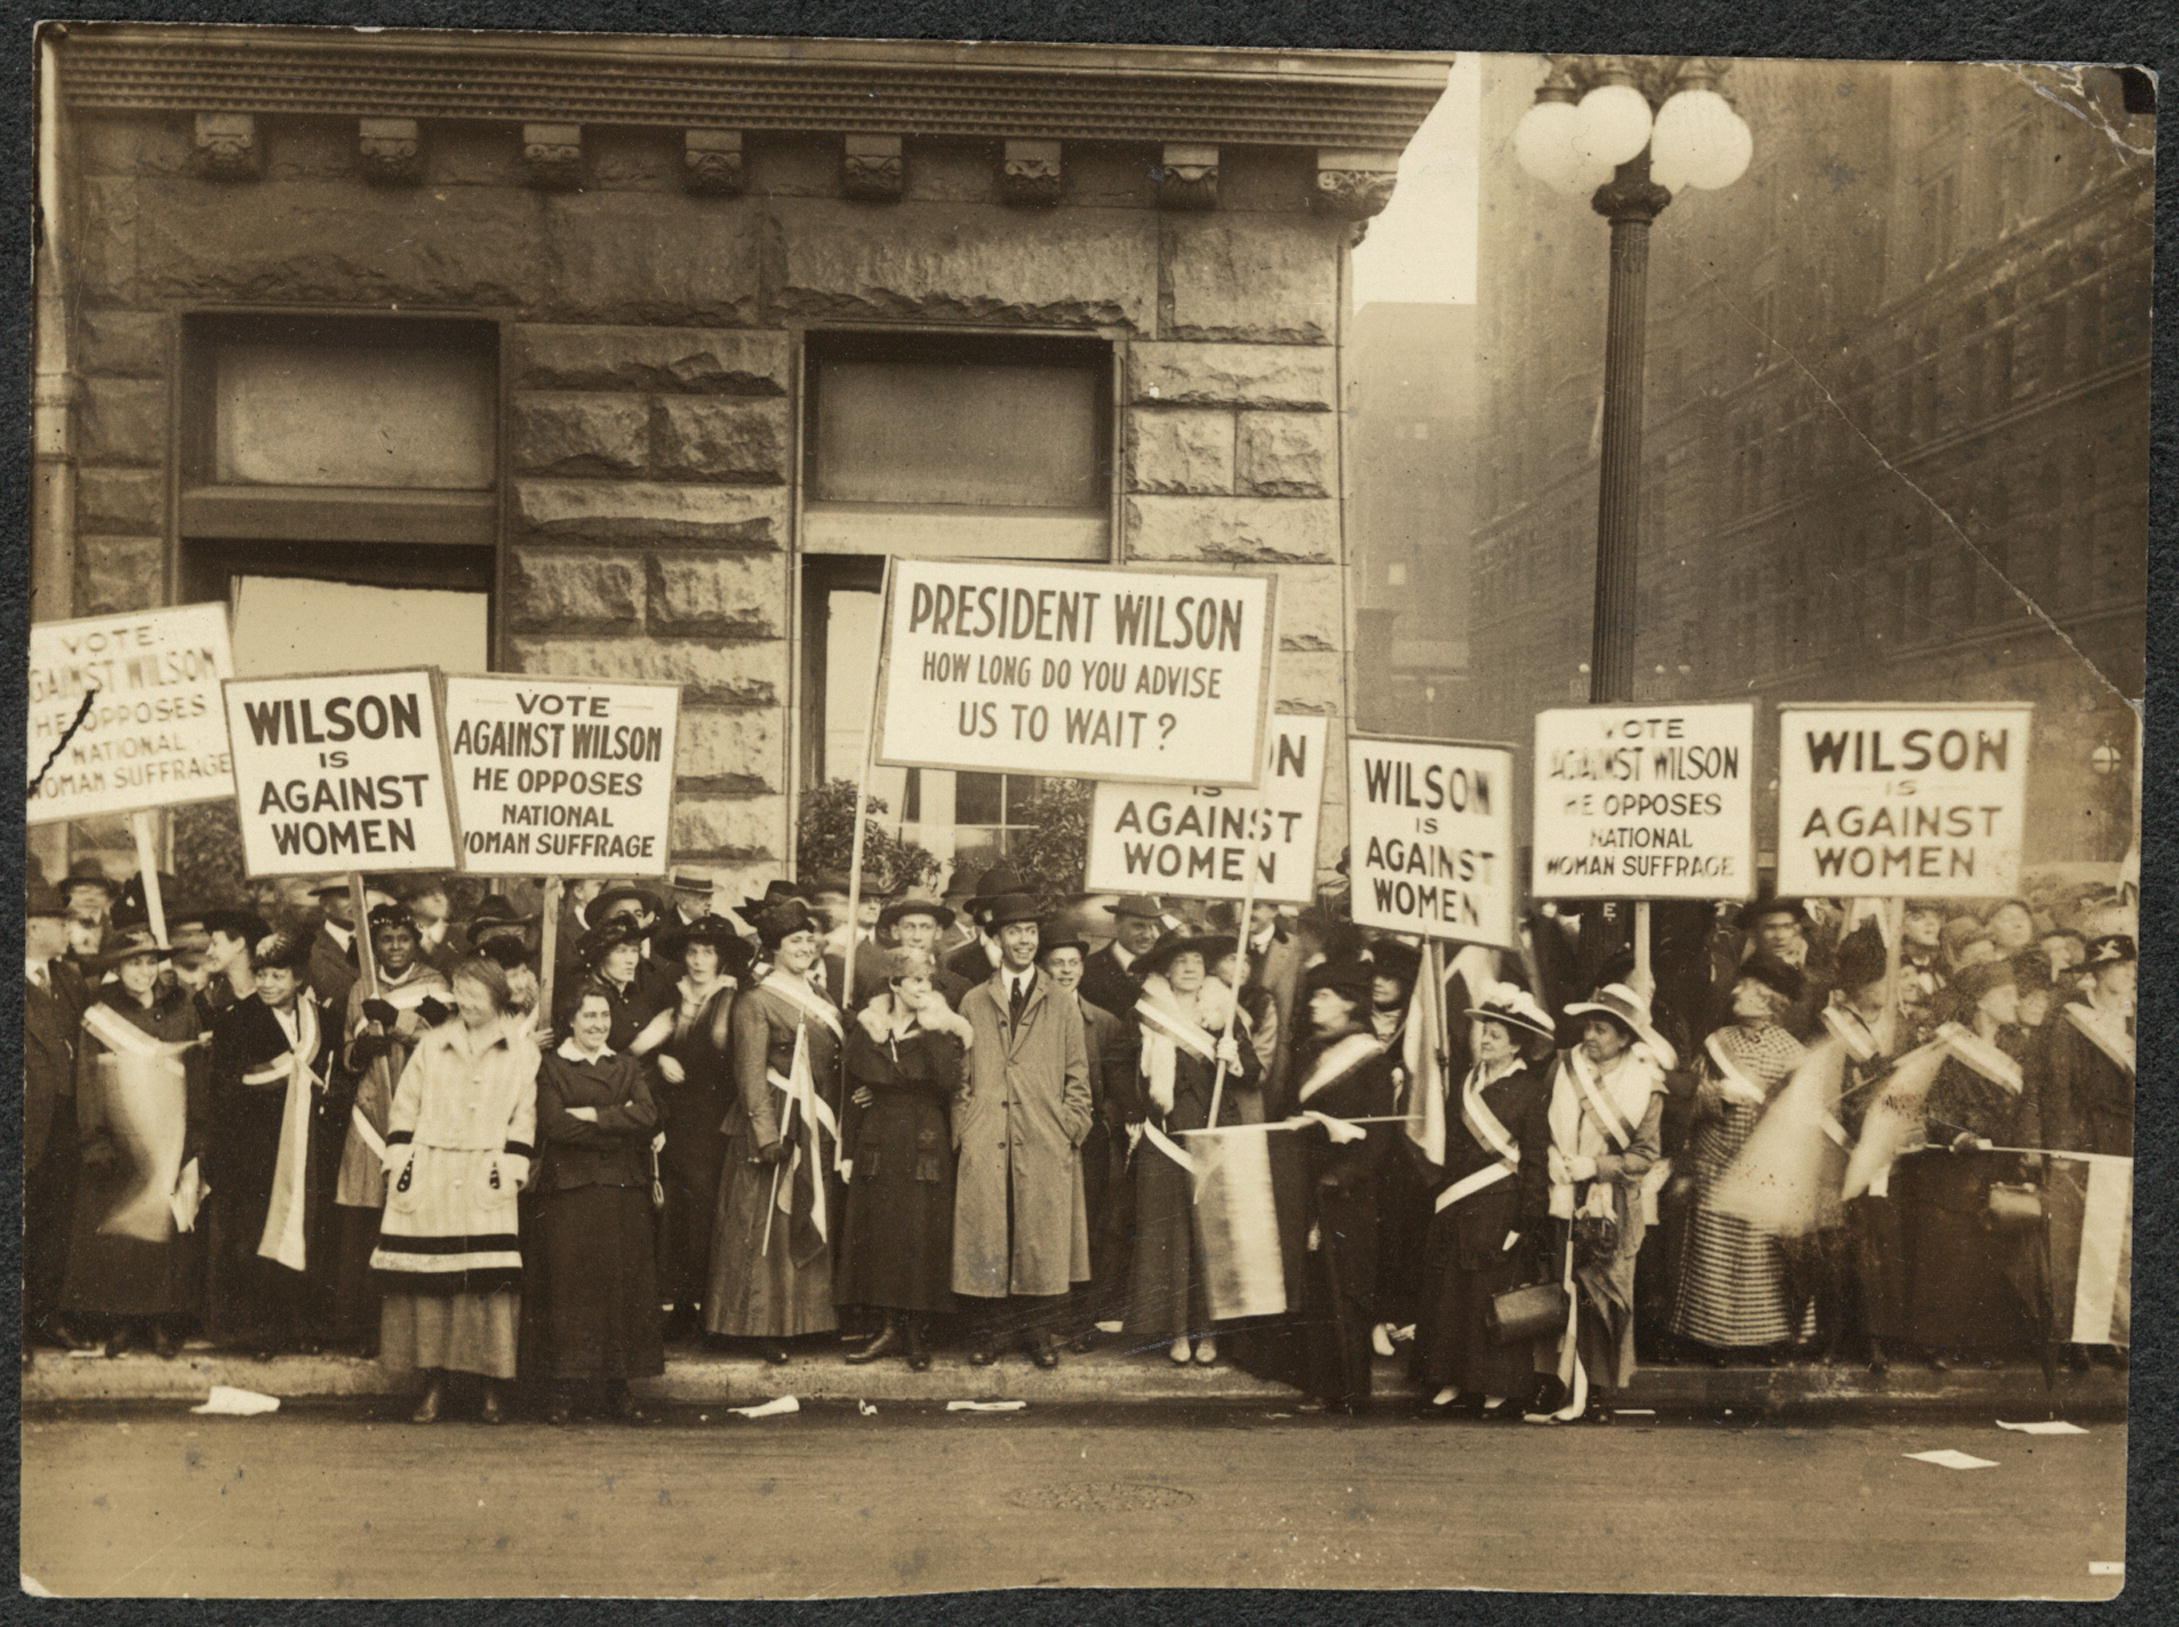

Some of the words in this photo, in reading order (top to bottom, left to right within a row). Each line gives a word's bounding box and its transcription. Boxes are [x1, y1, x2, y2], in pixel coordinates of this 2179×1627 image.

[909, 582, 1100, 643] PRESIDENT
[1114, 593, 1243, 652] WILSON
[61, 626, 153, 655] VOTE
[29, 660, 114, 703] GANST
[922, 651, 971, 683] HOW
[977, 655, 1031, 688] LONG
[1042, 658, 1072, 689] DO
[1082, 660, 1127, 694] YOU
[1135, 664, 1223, 699] ADVISE
[36, 712, 66, 737] HE
[82, 694, 206, 732] OPPOSES
[244, 693, 421, 746] WILSON
[515, 692, 610, 718] VOTE
[958, 701, 998, 738] US
[1011, 703, 1048, 742] TO
[73, 732, 187, 765] NATIONAL
[453, 719, 565, 759] AGAINST
[572, 723, 662, 762] WILSON
[1806, 729, 2008, 773] WILSON
[114, 752, 232, 789] SUFFRAGE
[319, 751, 349, 768] IS
[1651, 746, 1738, 781] WILSON
[258, 773, 429, 815] AGAINST
[472, 766, 510, 791] HE
[517, 768, 643, 797] OPPOSES
[1364, 757, 1493, 816] WILSON
[1885, 780, 1917, 796] IS
[501, 803, 614, 828] NATIONAL
[1113, 800, 1302, 843] AGAINST
[1604, 794, 1722, 816] OPPOSES
[1803, 806, 2003, 838] AGAINST
[271, 818, 416, 856] WOMEN
[1415, 816, 1439, 834] IS
[1590, 827, 1693, 848] NATIONAL
[463, 830, 530, 855] OMAN
[535, 833, 655, 858] SUFFRAGE
[1124, 841, 1276, 884] WOMEN
[1365, 835, 1495, 886] AGAINST
[1814, 846, 1975, 878] WOMEN
[1545, 855, 1615, 877] WOMAN
[1622, 855, 1735, 878] SUFFRAGE
[1372, 877, 1479, 927] WOMEN
